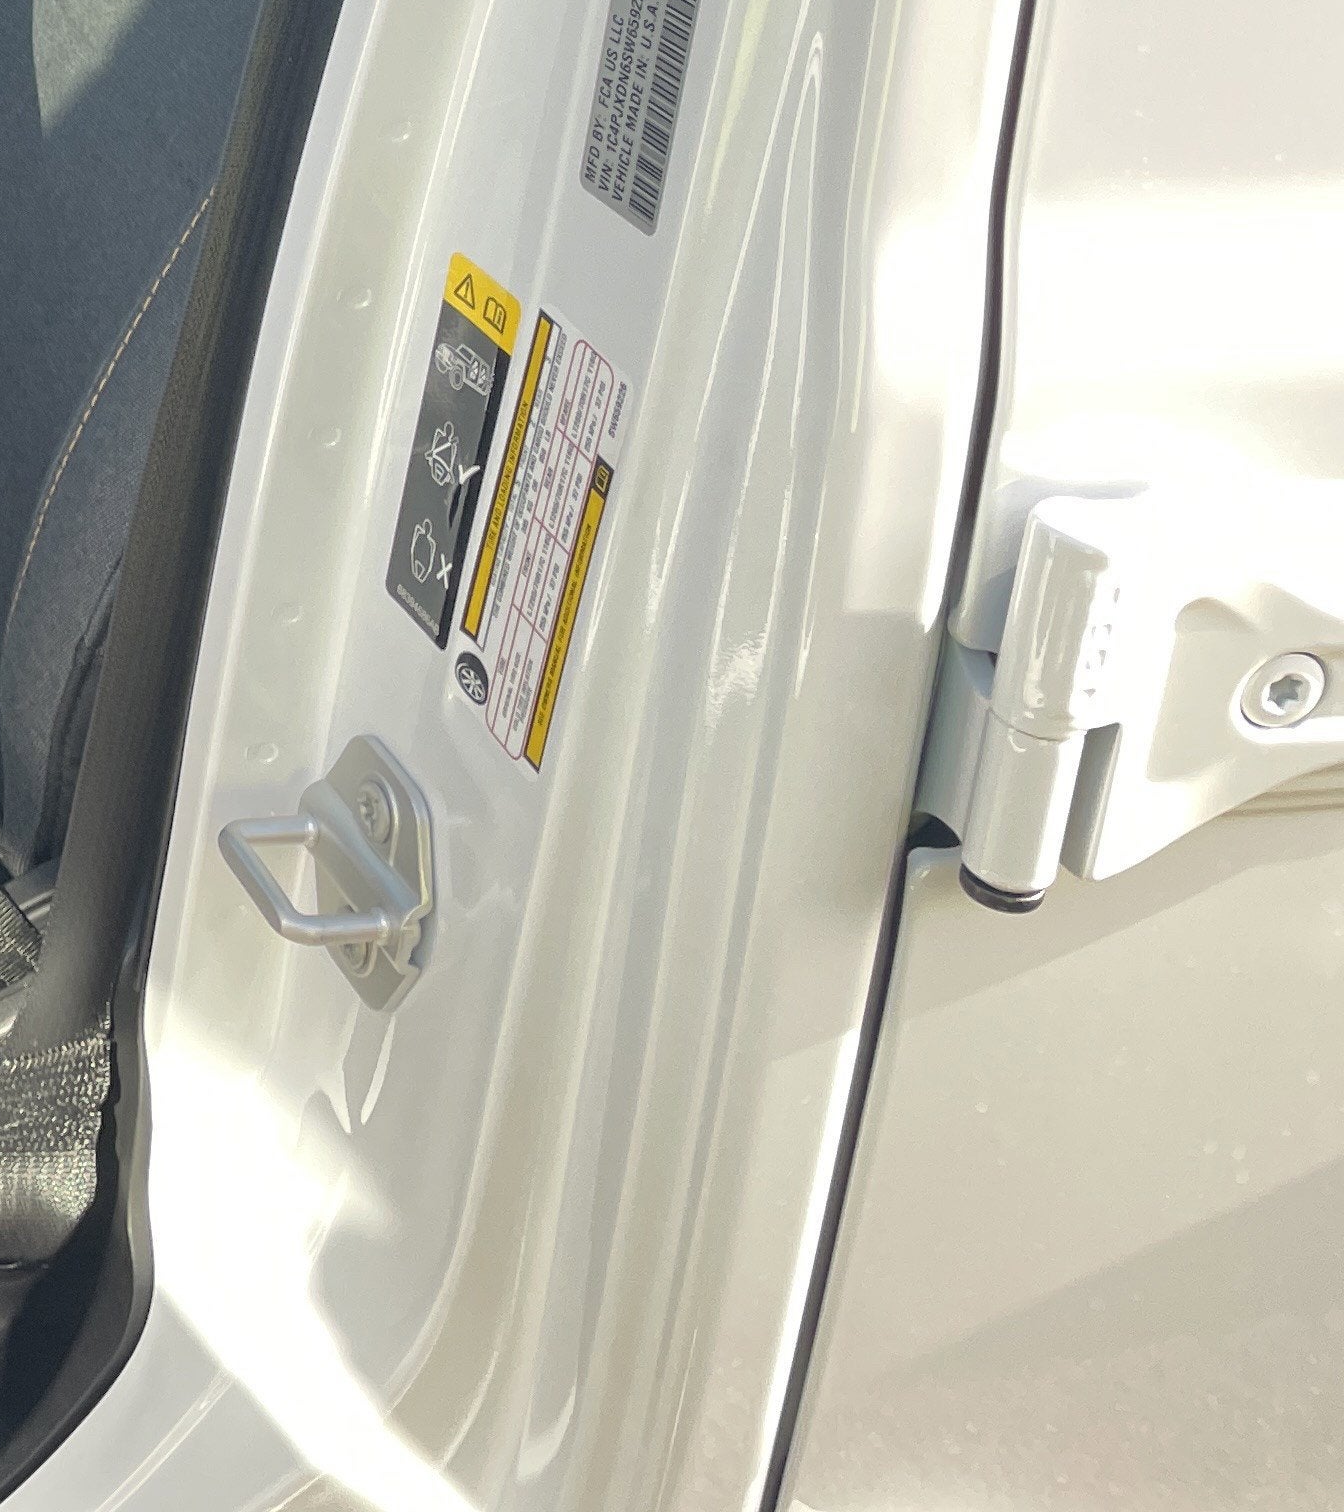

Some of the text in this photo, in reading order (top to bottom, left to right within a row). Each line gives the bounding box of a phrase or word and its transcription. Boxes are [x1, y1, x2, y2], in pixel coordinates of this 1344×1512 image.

[609, 12, 624, 45] LLC
[604, 47, 617, 72] US
[598, 73, 612, 109] FCA
[611, 133, 633, 204] VEHICLE
[625, 80, 643, 133] MADE
[584, 143, 600, 183] MFD
